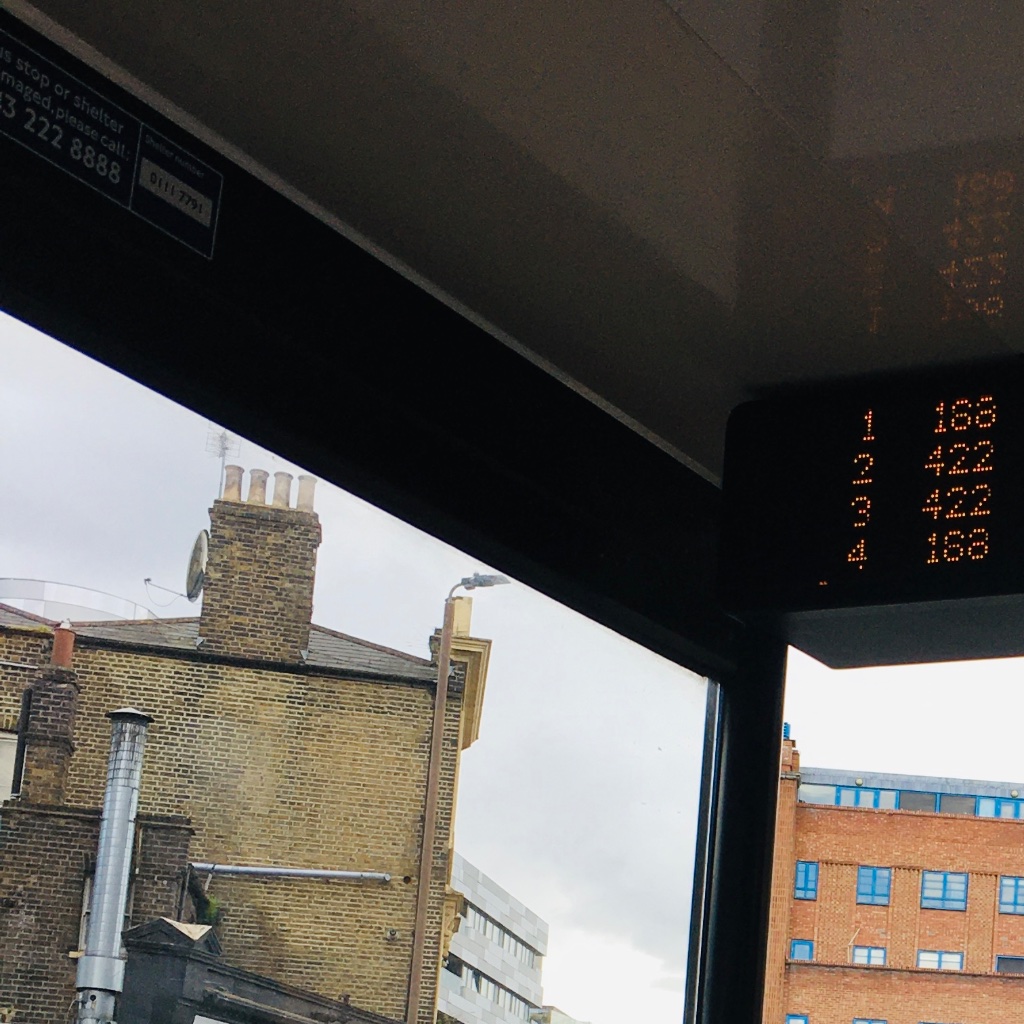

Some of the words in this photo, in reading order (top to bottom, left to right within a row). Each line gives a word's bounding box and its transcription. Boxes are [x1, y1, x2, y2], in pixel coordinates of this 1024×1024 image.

[16, 56, 50, 88] stop
[54, 82, 71, 99] or
[73, 95, 125, 135] shelter
[23, 106, 64, 150] 222
[70, 137, 121, 184] 8888
[56, 107, 100, 142] please
[851, 453, 874, 485] 2
[924, 437, 994, 477] 422
[850, 495, 872, 527] 3
[921, 483, 992, 520] 422
[846, 537, 869, 570] 4
